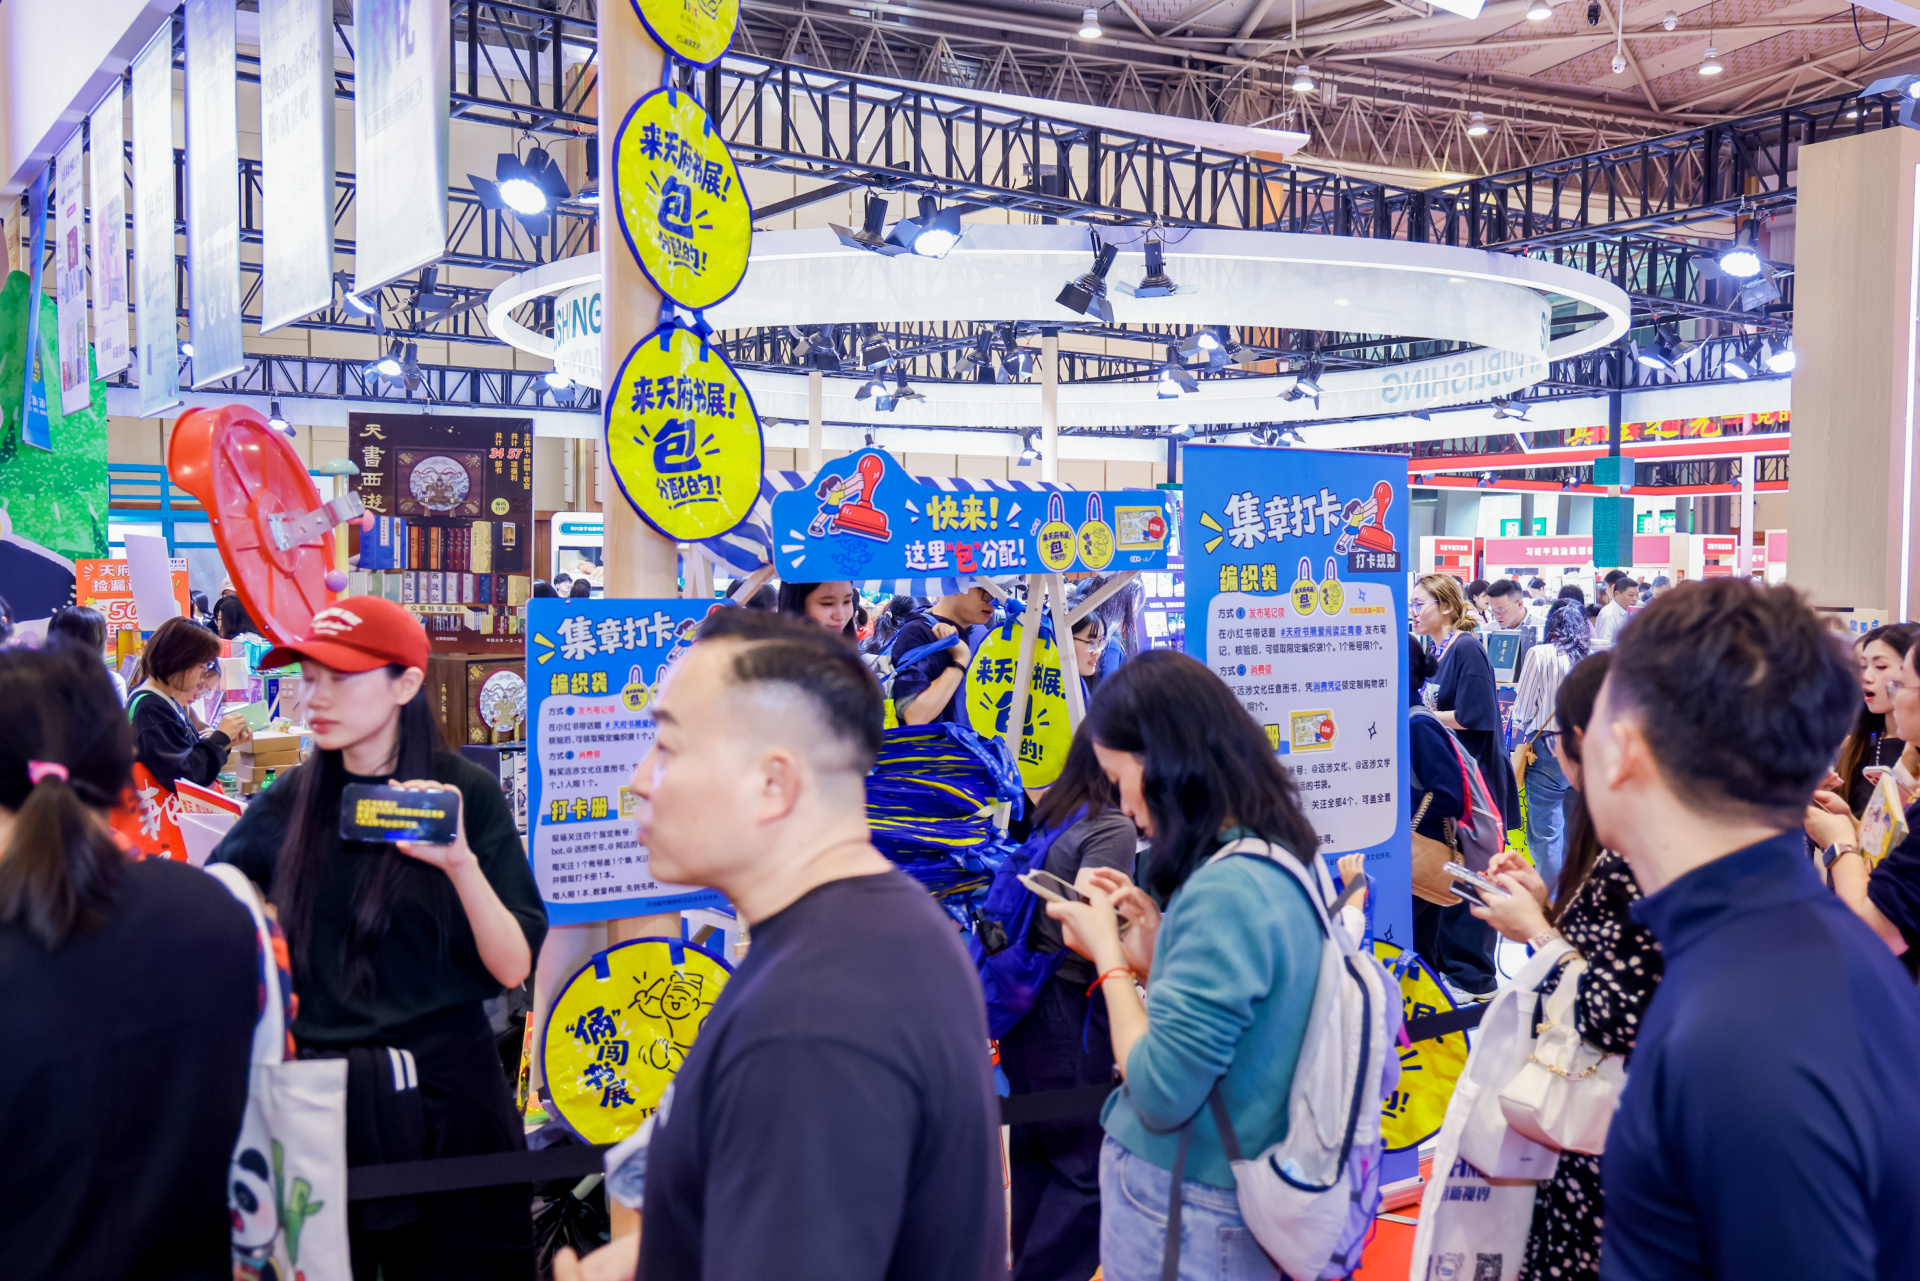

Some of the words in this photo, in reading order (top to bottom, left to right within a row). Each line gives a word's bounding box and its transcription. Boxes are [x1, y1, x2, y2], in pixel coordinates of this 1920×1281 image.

[639, 122, 732, 202] 来天府书展!
[657, 175, 694, 240] 包
[657, 230, 708, 272] 分配的!
[631, 374, 736, 420] 来天府书展!
[652, 418, 702, 474] 包
[656, 474, 721, 500] 分配的!
[926, 494, 999, 532] 快来!
[1223, 487, 1342, 549] 集章打卡
[1050, 541, 1064, 554] 包
[1355, 553, 1396, 569] 打卡规则
[1219, 563, 1278, 592] 编织袋
[1249, 607, 1286, 619] 发布笔记领
[556, 611, 676, 661] 集章打卡
[1218, 627, 1276, 640] 在小红书带话题
[1280, 625, 1364, 639] #天府书展爱阅读正青春
[1365, 624, 1387, 635] 发布笔
[551, 671, 608, 695] 编织袋
[1250, 664, 1272, 676] 消费领
[548, 721, 602, 732] 在小红书带话题
[550, 796, 608, 822] 打卡册
